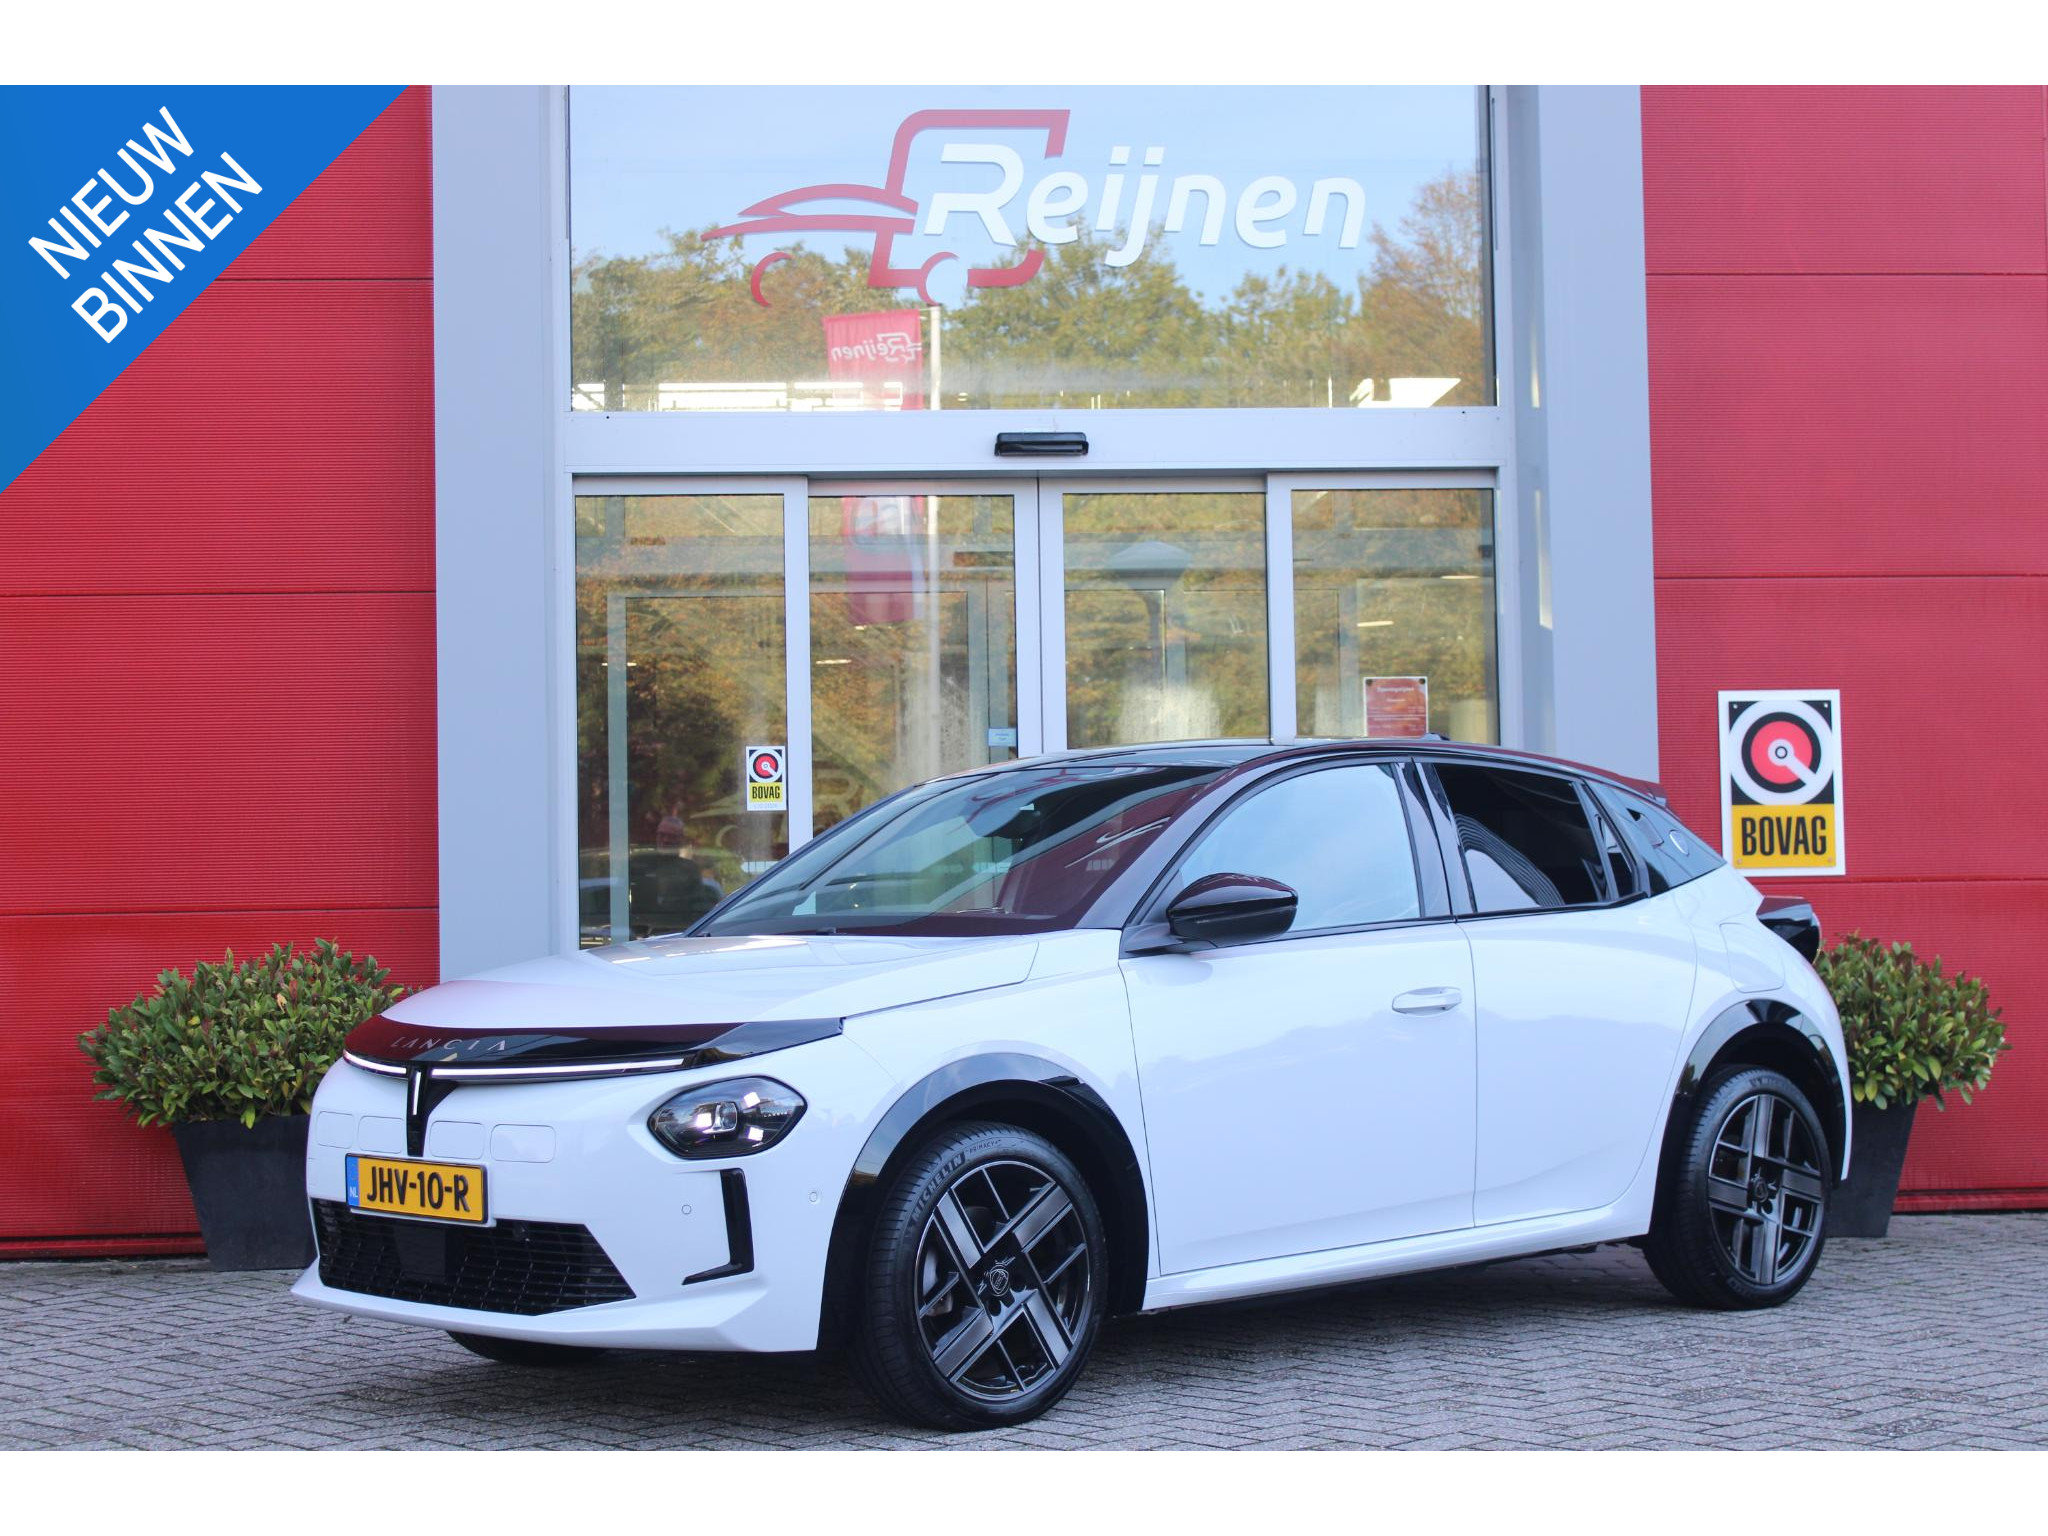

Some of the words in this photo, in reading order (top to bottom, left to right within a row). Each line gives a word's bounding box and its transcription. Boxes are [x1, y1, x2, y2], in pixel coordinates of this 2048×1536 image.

[923, 143, 1366, 268] Reijnen
[752, 786, 780, 799] BOVAG
[1741, 815, 1827, 856] BOVAG
[390, 1037, 506, 1051] LANCIA
[349, 1186, 359, 1198] NL
[367, 1166, 471, 1212] JHV-10-R
[911, 1151, 966, 1221] MICHELIN
